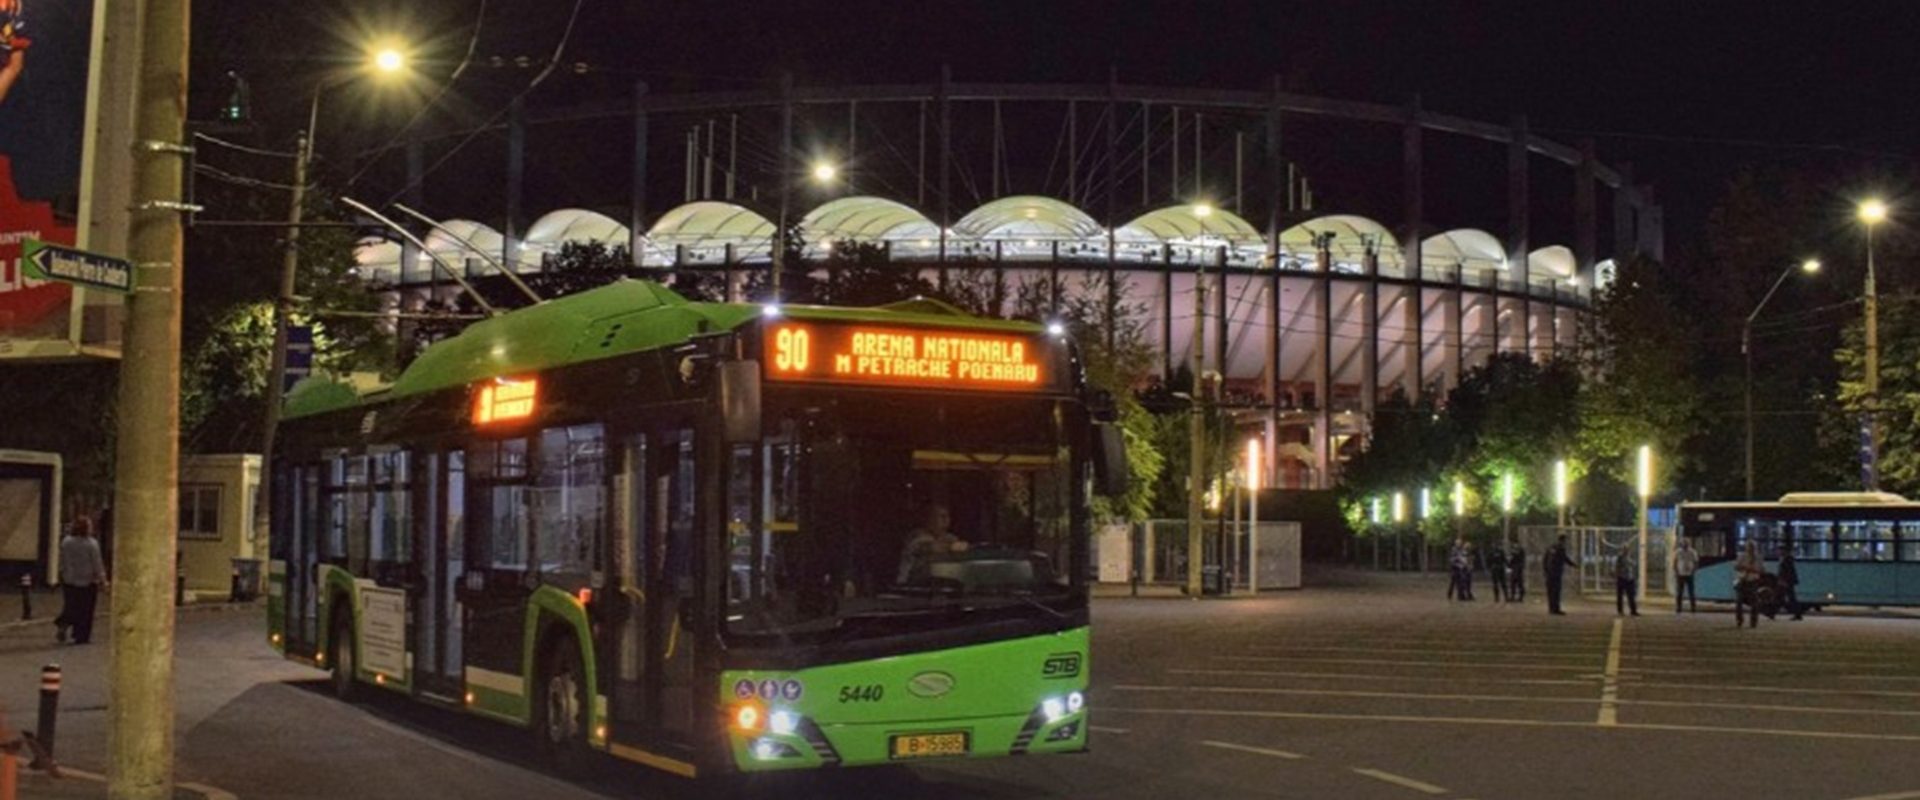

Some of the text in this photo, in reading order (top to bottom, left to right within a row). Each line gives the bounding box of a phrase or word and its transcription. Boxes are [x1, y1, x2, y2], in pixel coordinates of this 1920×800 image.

[776, 328, 809, 371] 90
[852, 332, 1024, 363] ARENA NATIONALA
[836, 354, 1038, 383] M PETRACHE POENARU
[1042, 657, 1078, 675] STB
[838, 684, 884, 704] 5440
